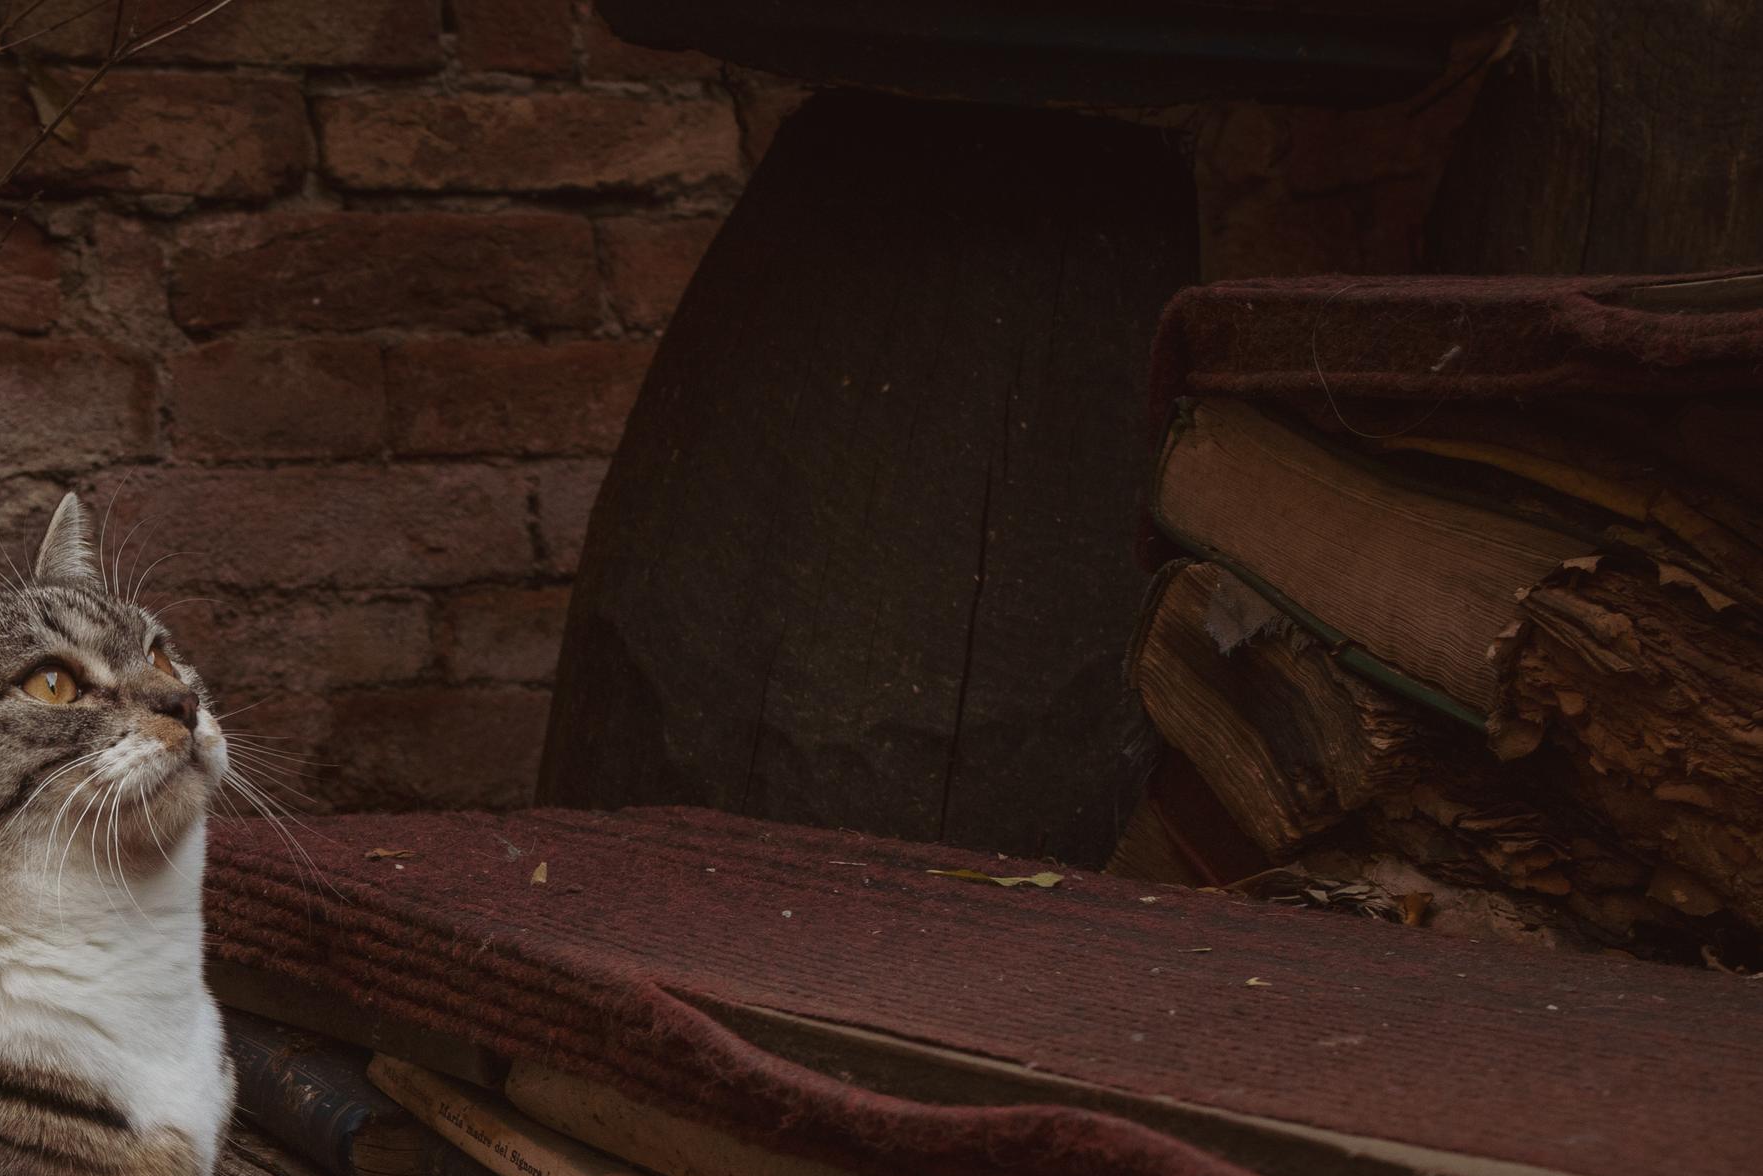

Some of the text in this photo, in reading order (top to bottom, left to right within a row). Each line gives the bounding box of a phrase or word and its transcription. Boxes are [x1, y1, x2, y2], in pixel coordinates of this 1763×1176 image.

[438, 1102, 464, 1129] Maria
[466, 1126, 492, 1148] madre
[494, 1140, 509, 1158] del
